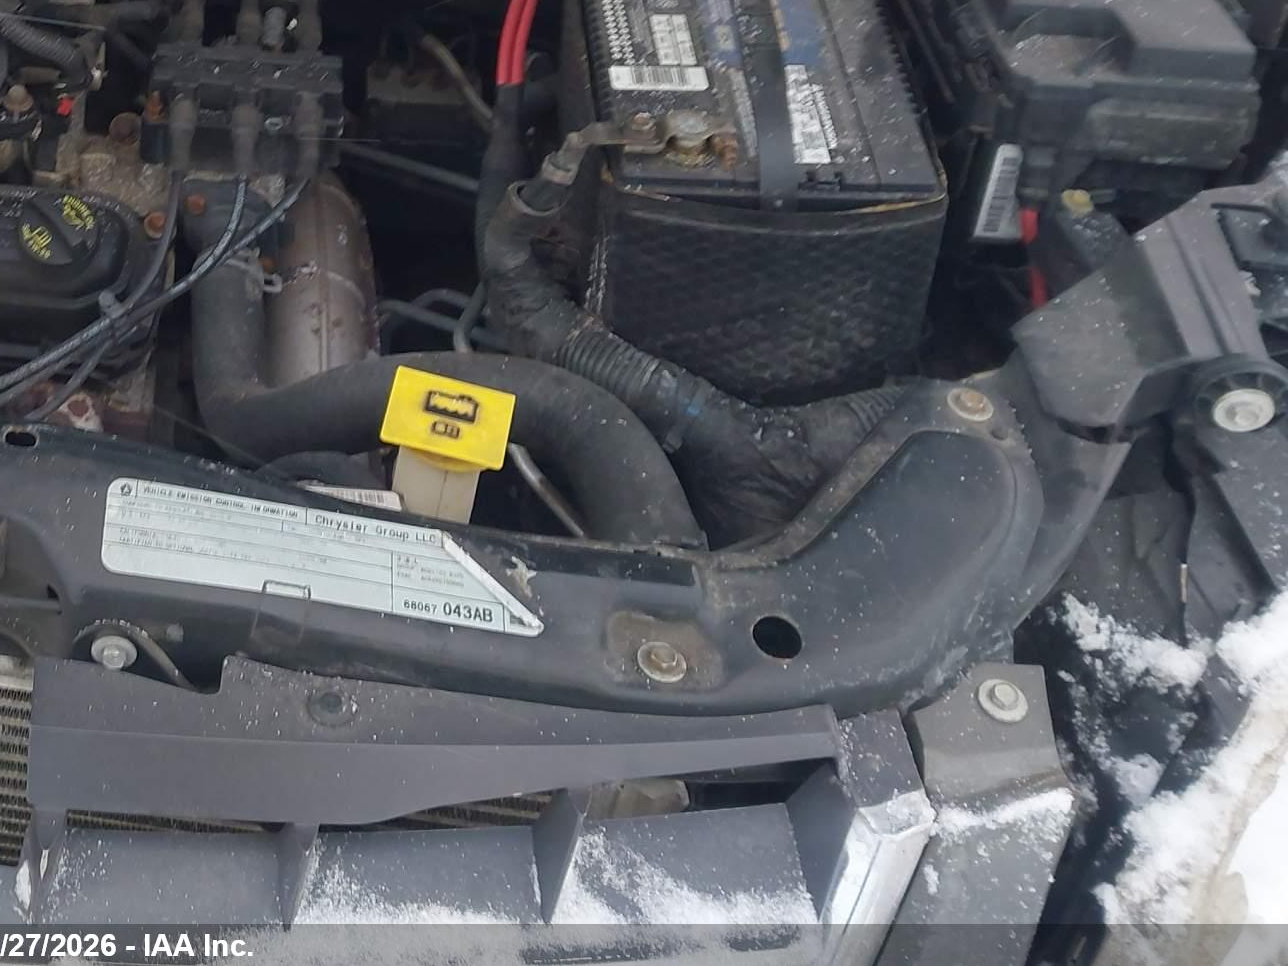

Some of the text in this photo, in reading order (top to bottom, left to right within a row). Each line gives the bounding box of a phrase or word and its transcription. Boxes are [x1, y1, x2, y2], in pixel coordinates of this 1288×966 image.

[314, 514, 369, 534] Chrysler
[375, 525, 410, 542] Group
[414, 532, 437, 544] LLC
[403, 600, 494, 623] 68067 043AB
